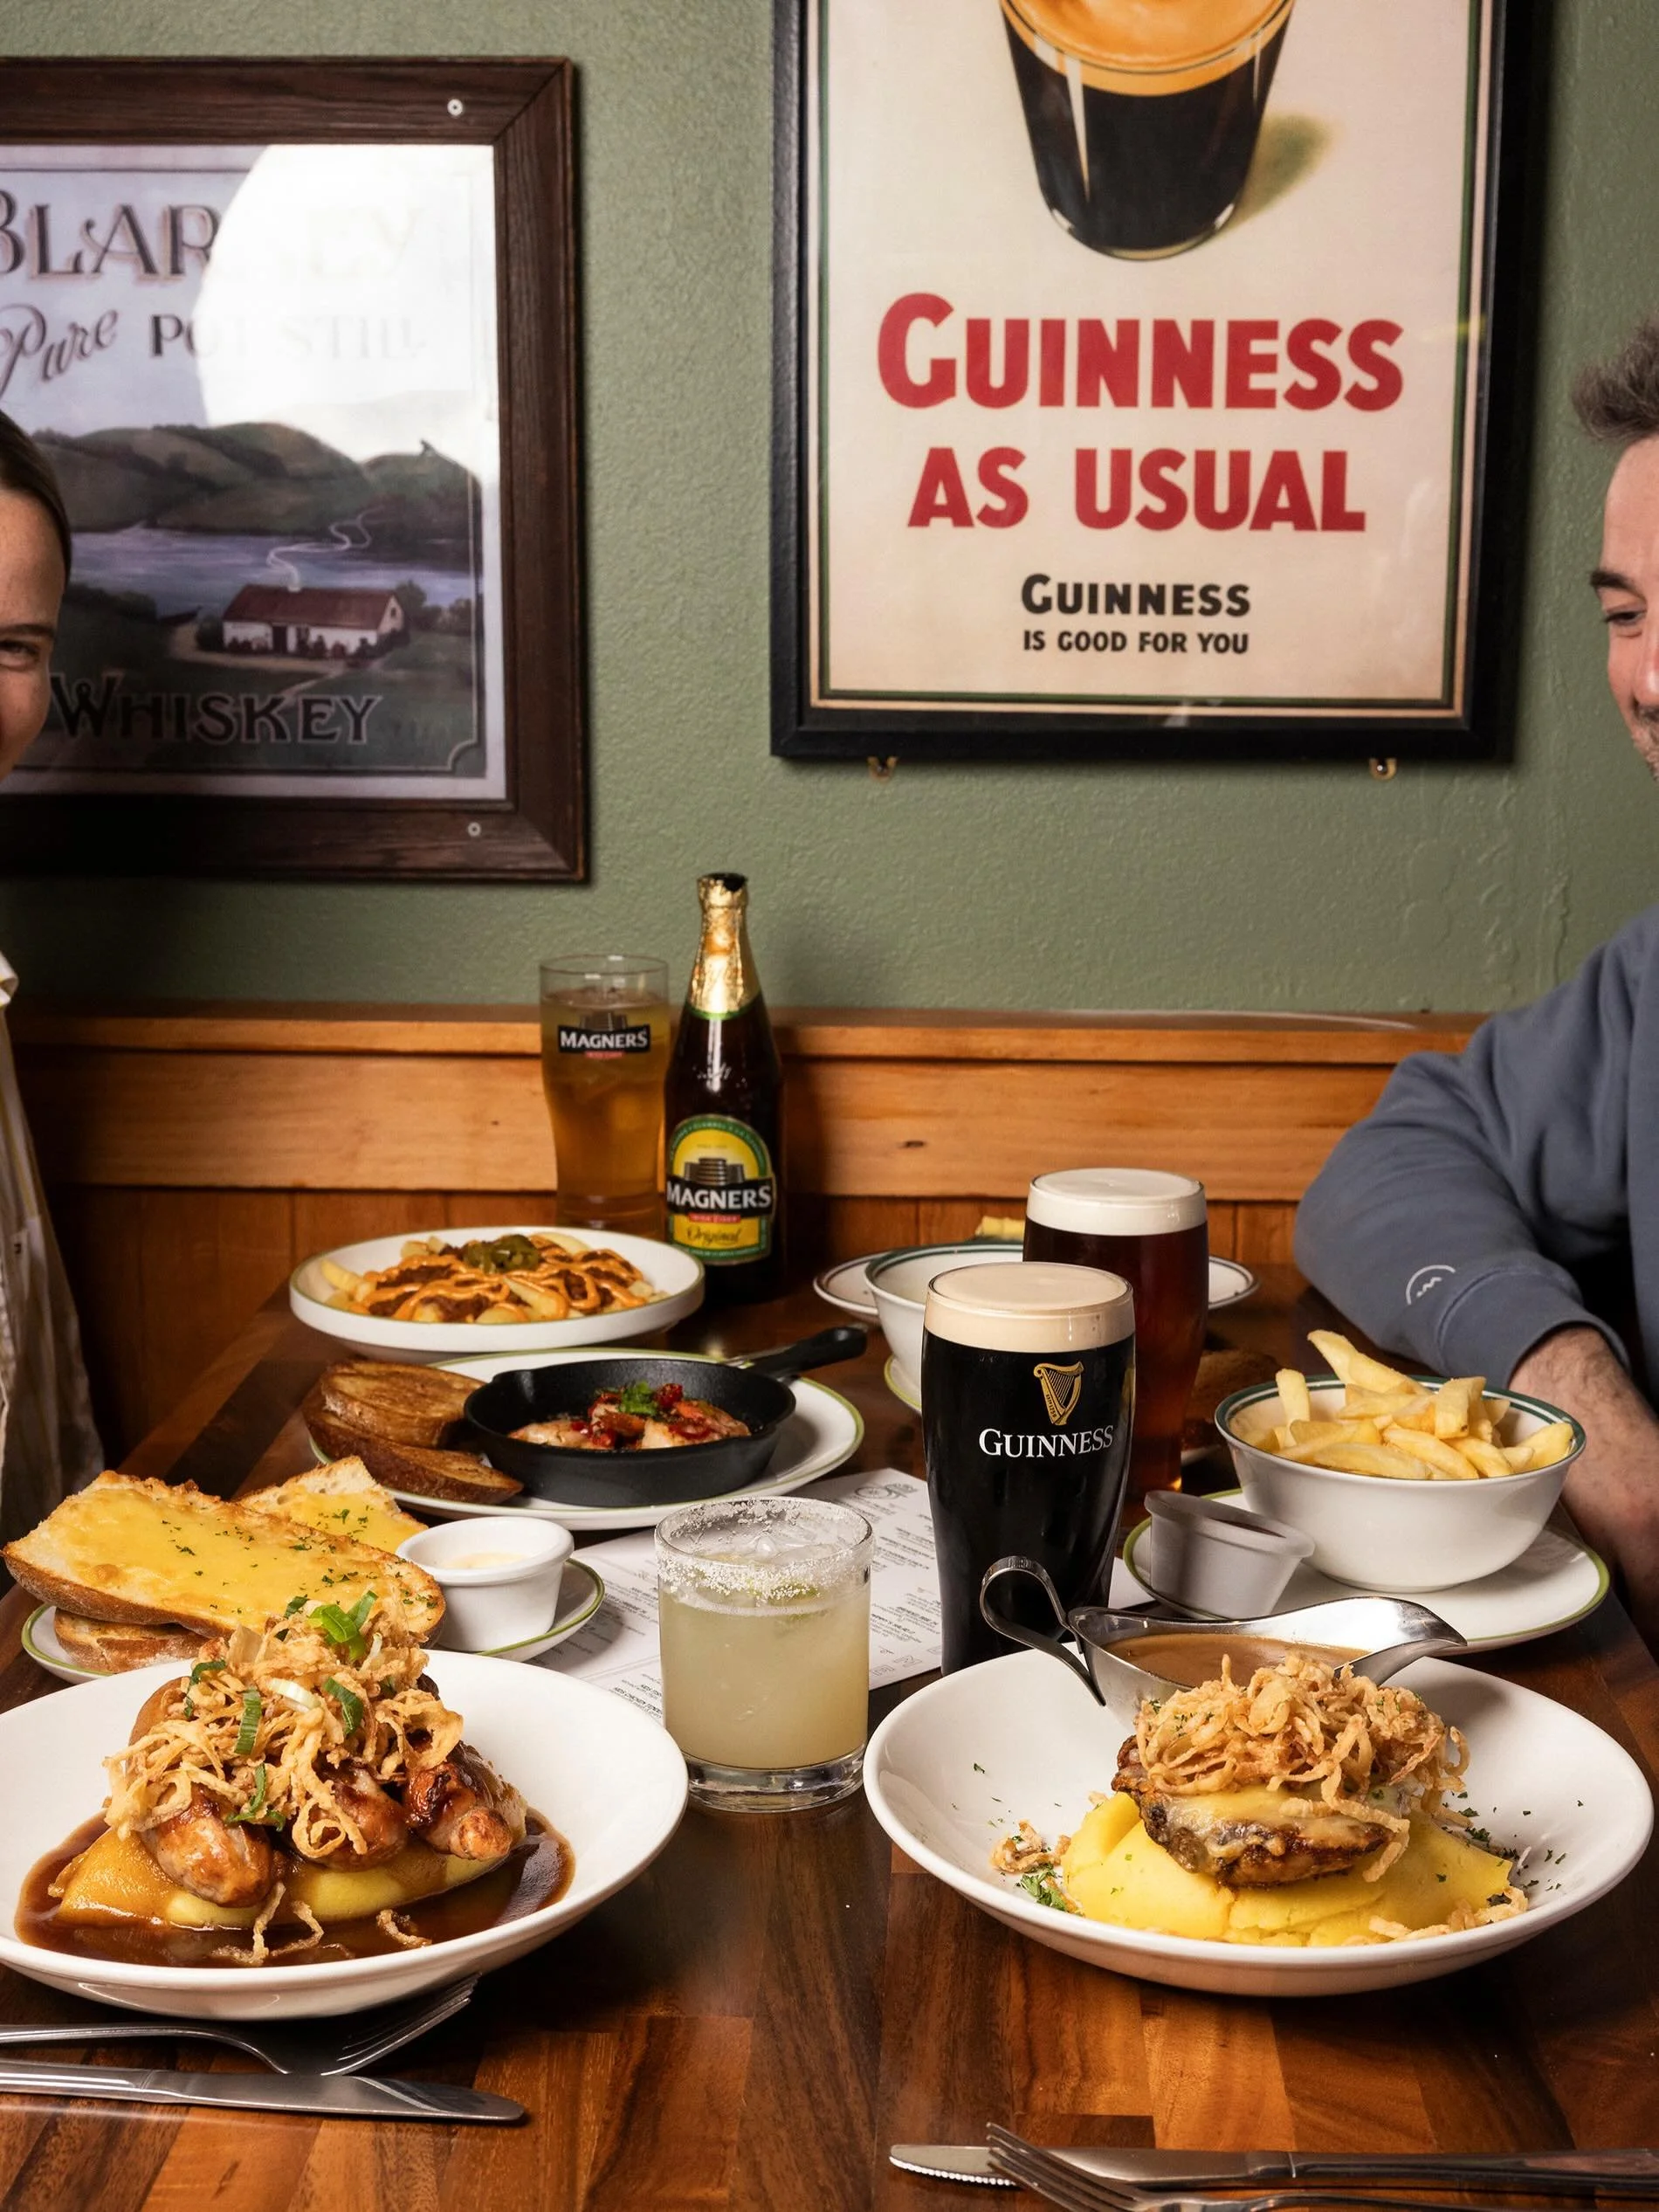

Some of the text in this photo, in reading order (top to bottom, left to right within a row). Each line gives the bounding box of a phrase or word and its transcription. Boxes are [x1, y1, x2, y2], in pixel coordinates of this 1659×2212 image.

[878, 293, 1405, 413] GUINNESS
[907, 446, 1367, 533] AS USUAL
[1021, 573, 1251, 617] GUINNESS
[1023, 630, 1249, 655] IS GOOD FOR YOU
[51, 672, 382, 745] WHISKEY
[561, 1030, 648, 1049] MAGNERS
[666, 1180, 772, 1209] MAGNERS
[979, 1425, 1113, 1458] GUINNESS
